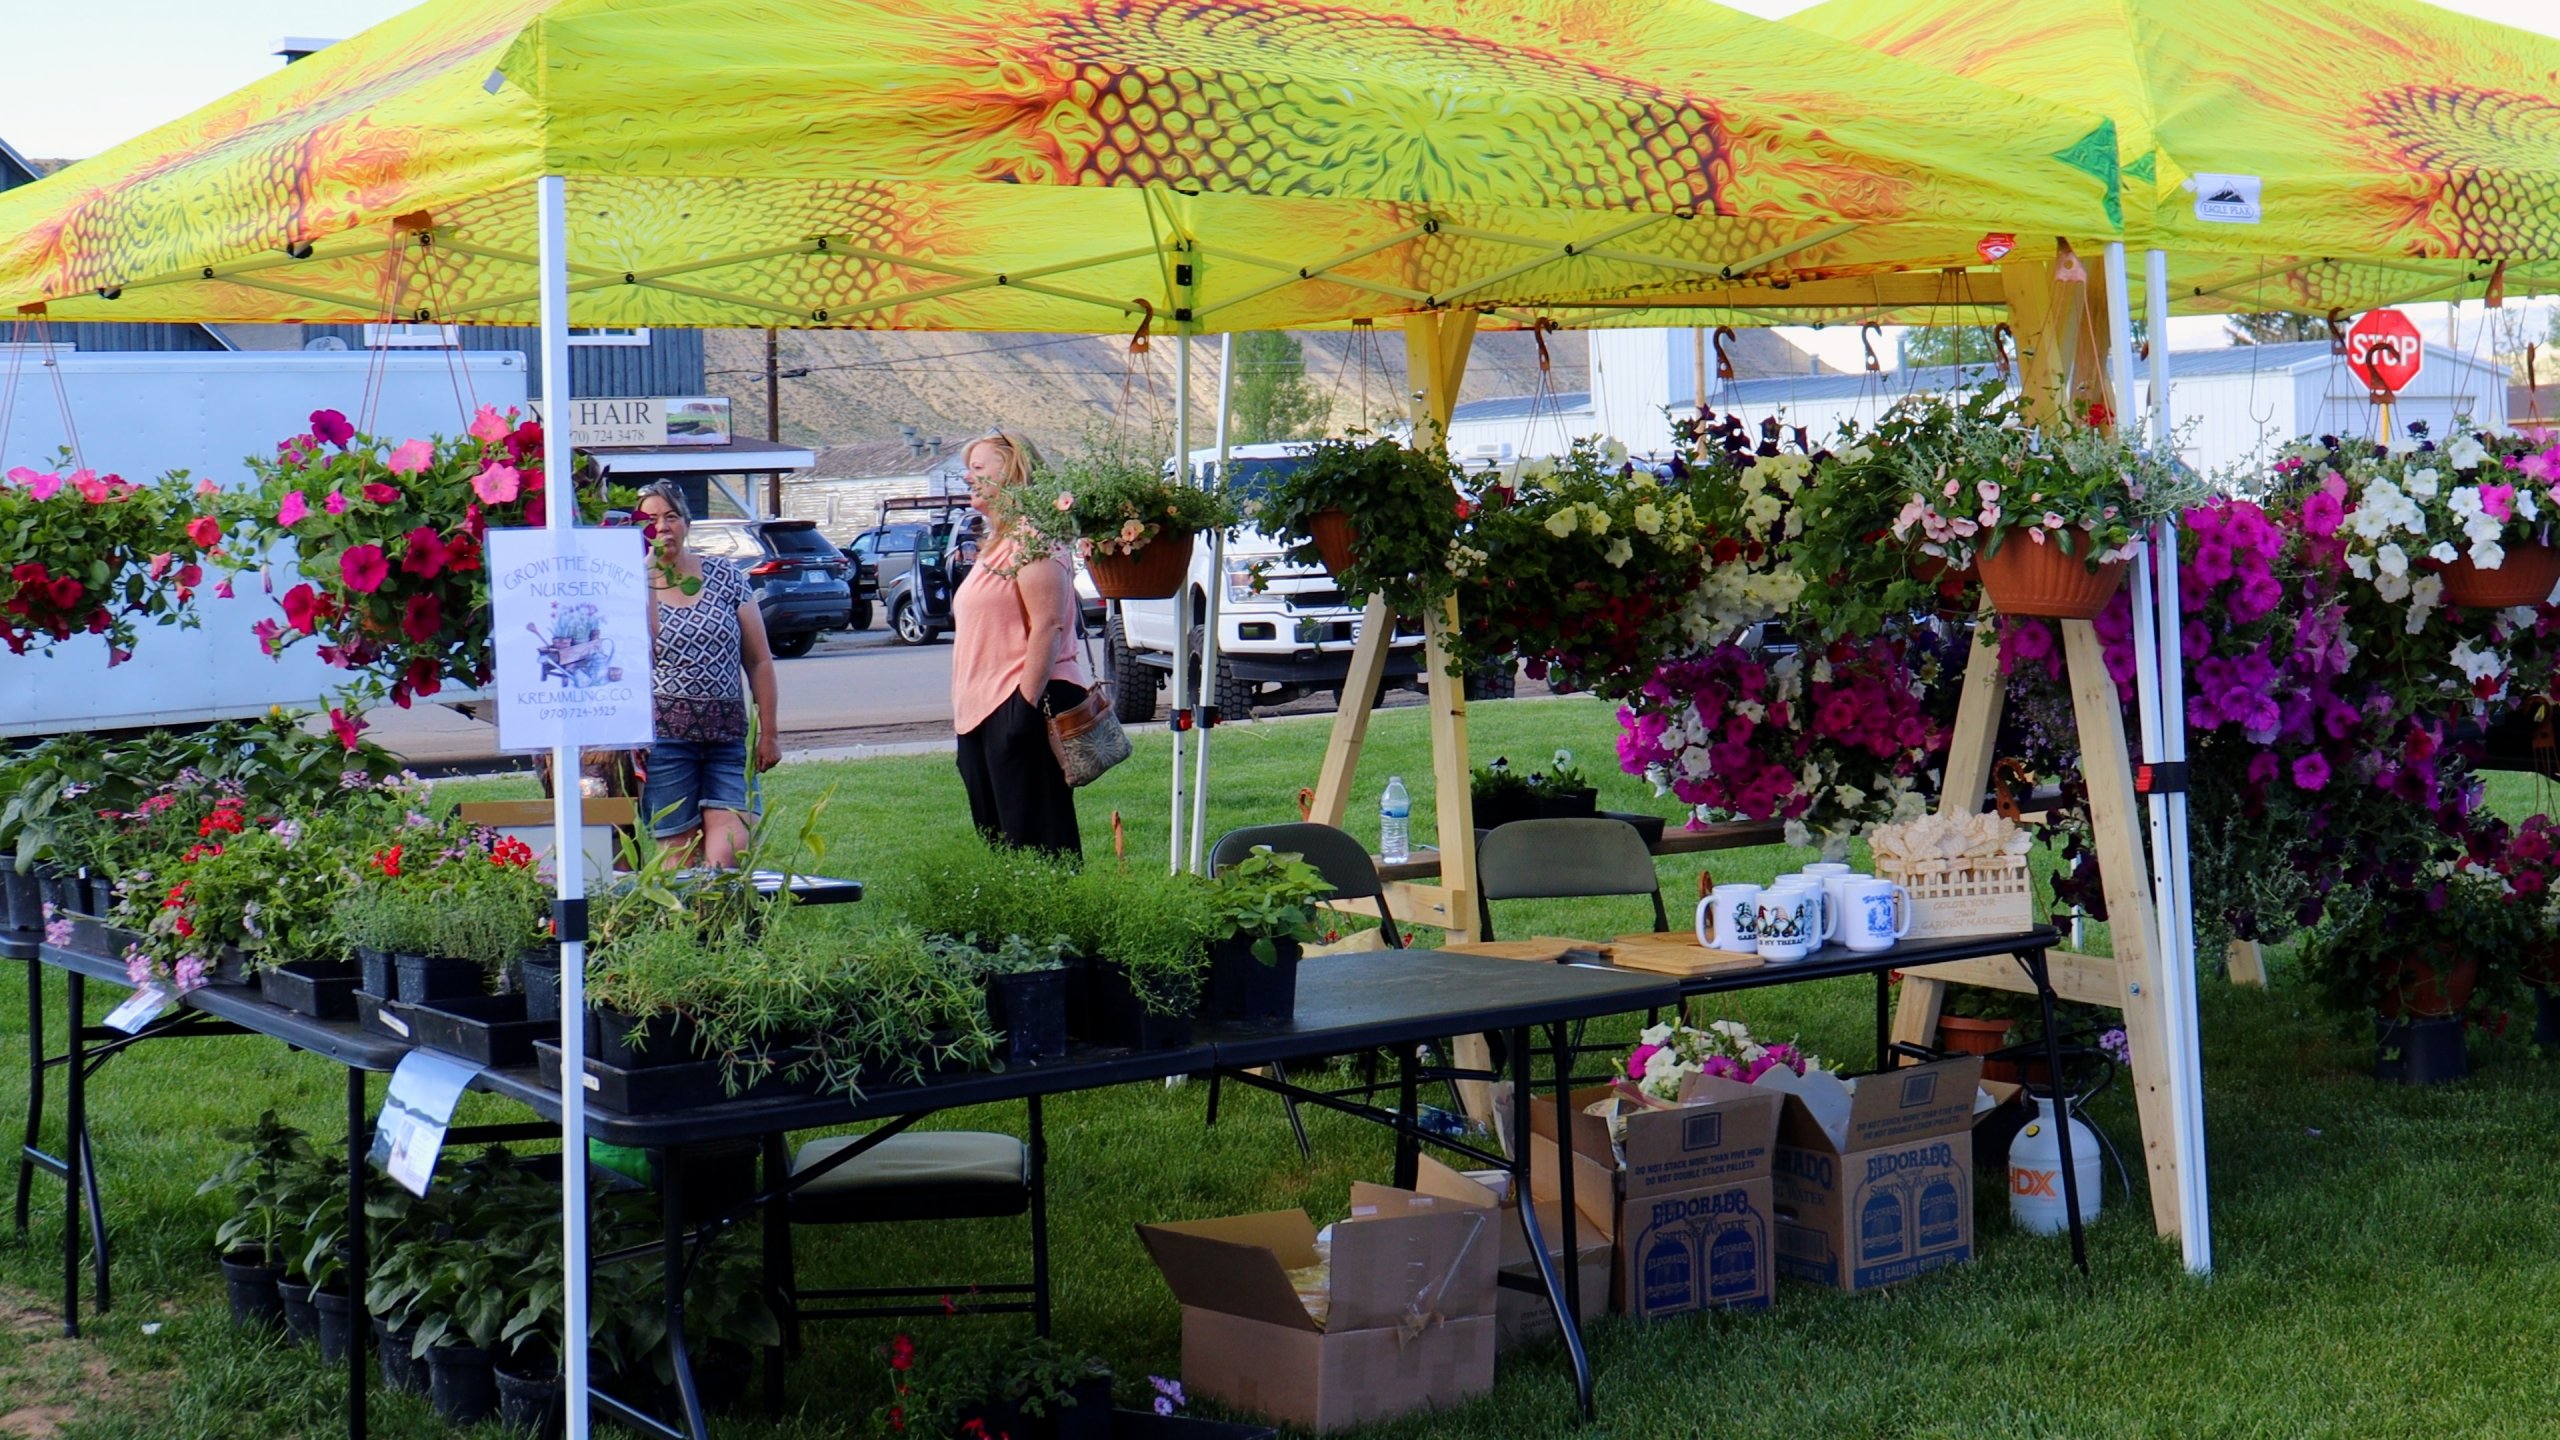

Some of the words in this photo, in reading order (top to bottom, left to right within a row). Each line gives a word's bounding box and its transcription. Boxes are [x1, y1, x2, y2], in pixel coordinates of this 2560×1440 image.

[2203, 204, 2229, 214] EAGLE
[2230, 206, 2251, 216] PEAK
[2351, 333, 2419, 367] STOP
[580, 402, 652, 425] HAIR
[593, 430, 613, 442] 724
[617, 429, 645, 442] 3478
[503, 559, 550, 590] GROW
[552, 556, 588, 572] THE
[590, 558, 635, 588] SHIRE
[530, 581, 611, 597] NURSERY
[1921, 920, 1963, 930] GARDEN
[1635, 1166, 1645, 1176] DO
[1647, 1164, 1663, 1173] NOT
[1663, 1160, 1687, 1171] STACK
[1688, 1156, 1709, 1167] MORE
[1710, 1153, 1730, 1164] THAN
[1730, 1150, 1746, 1160] FIVE
[1747, 1147, 1765, 1157] HIGH
[1867, 1143, 1952, 1184] ELDORADO
[1645, 1176, 1656, 1186] DO
[1657, 1174, 1671, 1184] NOT
[1673, 1169, 1700, 1181] DOUBLE
[1702, 1165, 1725, 1176] STACK
[1726, 1160, 1755, 1172] PALLETS
[1652, 1189, 1748, 1231] ELDORADO
[1712, 1241, 1753, 1259] ELDORADO
[1647, 1253, 1689, 1271] ELDORADO
[1884, 1261, 1918, 1278] GALLON
